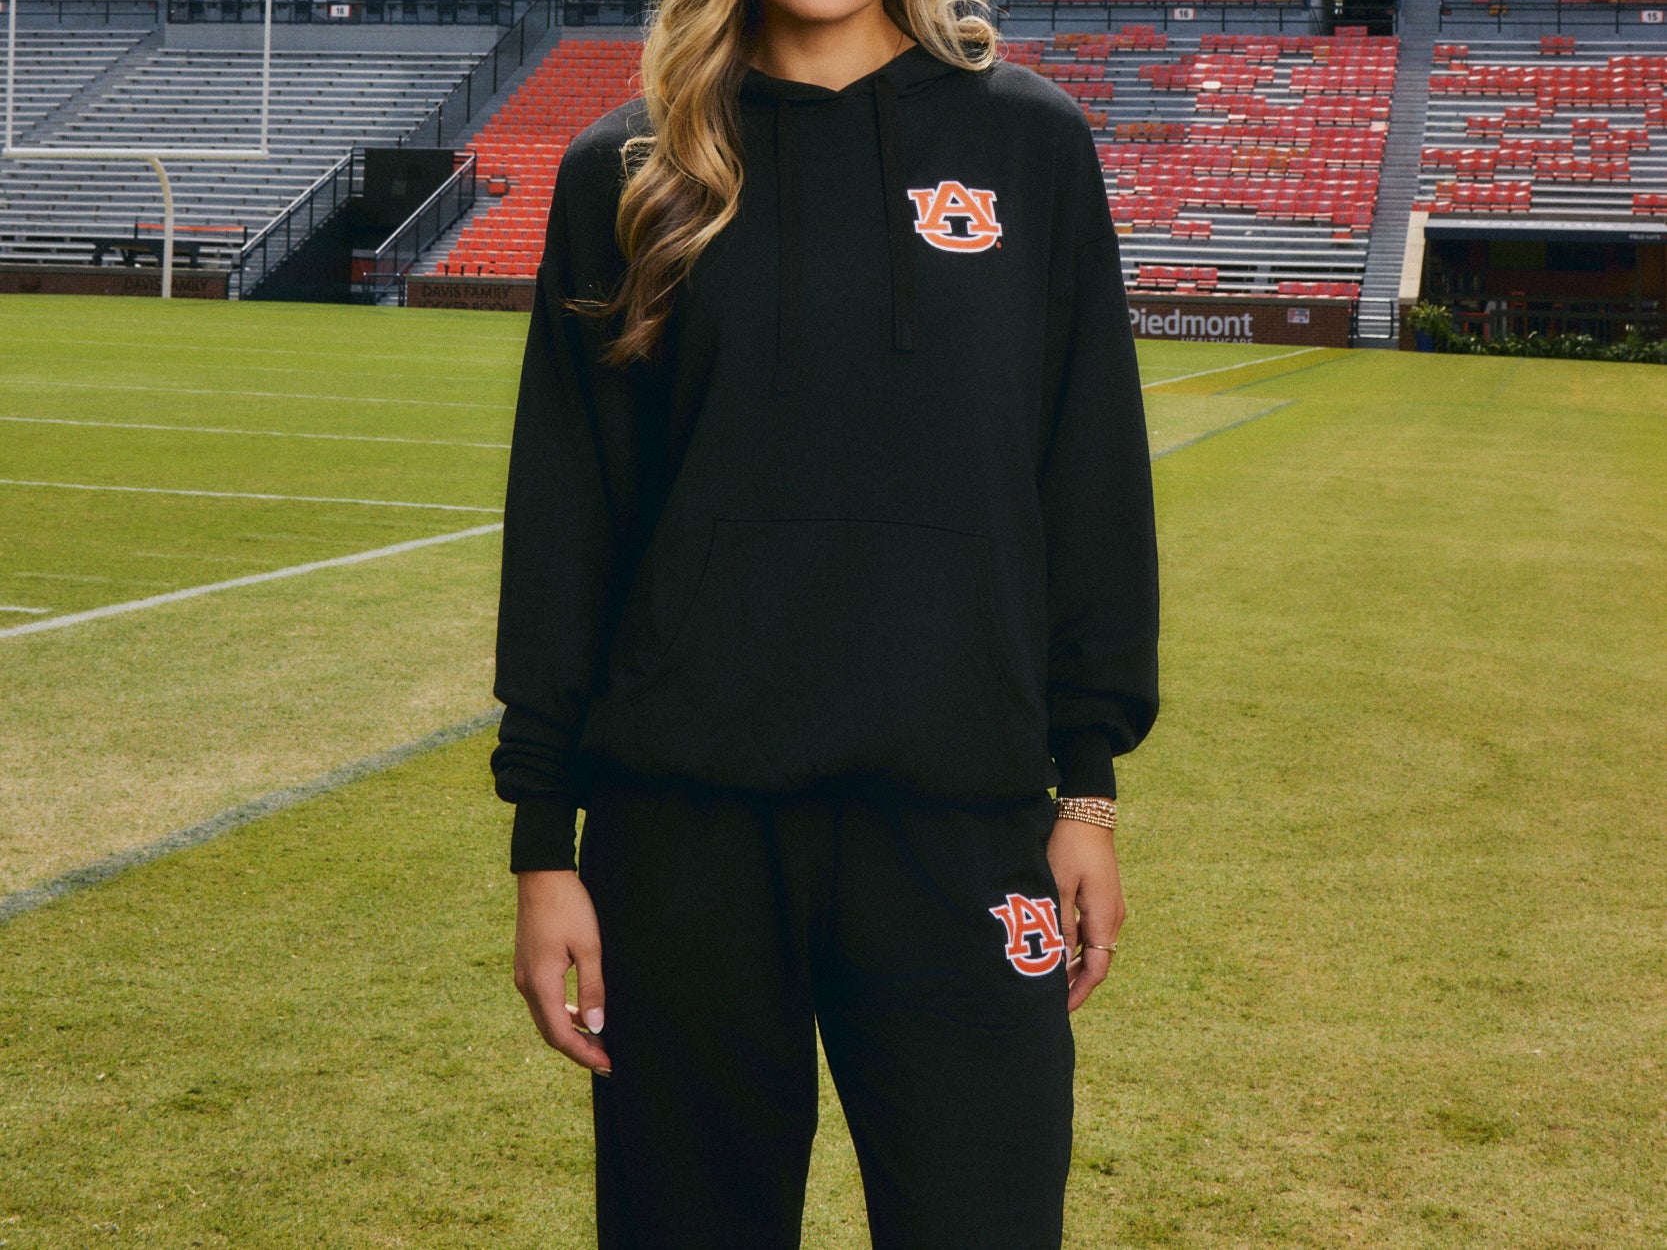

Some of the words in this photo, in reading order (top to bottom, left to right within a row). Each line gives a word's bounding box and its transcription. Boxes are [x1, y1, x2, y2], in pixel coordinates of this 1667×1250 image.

[171, 279, 208, 292] AMILY
[423, 285, 461, 298] DAVIS
[464, 285, 511, 299] FAMILY
[1128, 308, 1254, 337] Piedmont
